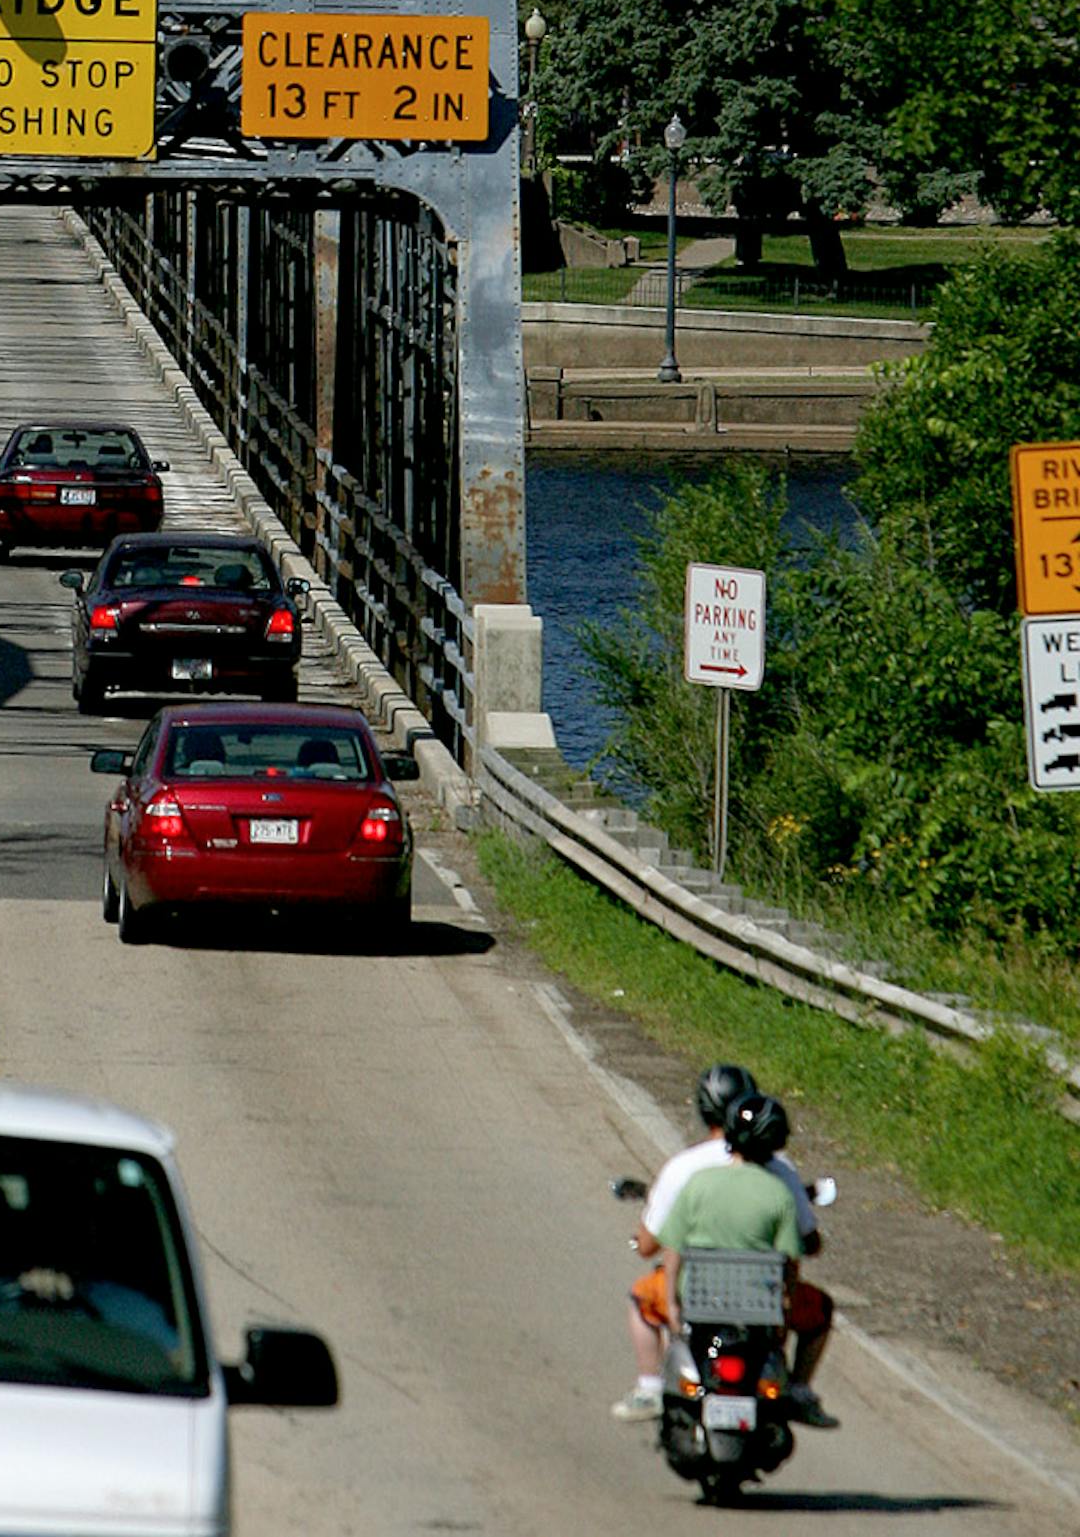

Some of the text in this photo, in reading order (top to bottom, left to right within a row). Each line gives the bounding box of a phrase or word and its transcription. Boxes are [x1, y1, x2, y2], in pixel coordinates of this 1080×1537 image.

[258, 31, 473, 71] CLEARANCE
[40, 59, 134, 89] STOP
[267, 83, 463, 122] 13 FT 2 IN
[714, 578, 738, 600] NO
[695, 603, 757, 631] PARKING
[713, 630, 737, 645] ANY
[710, 645, 740, 663] TIME
